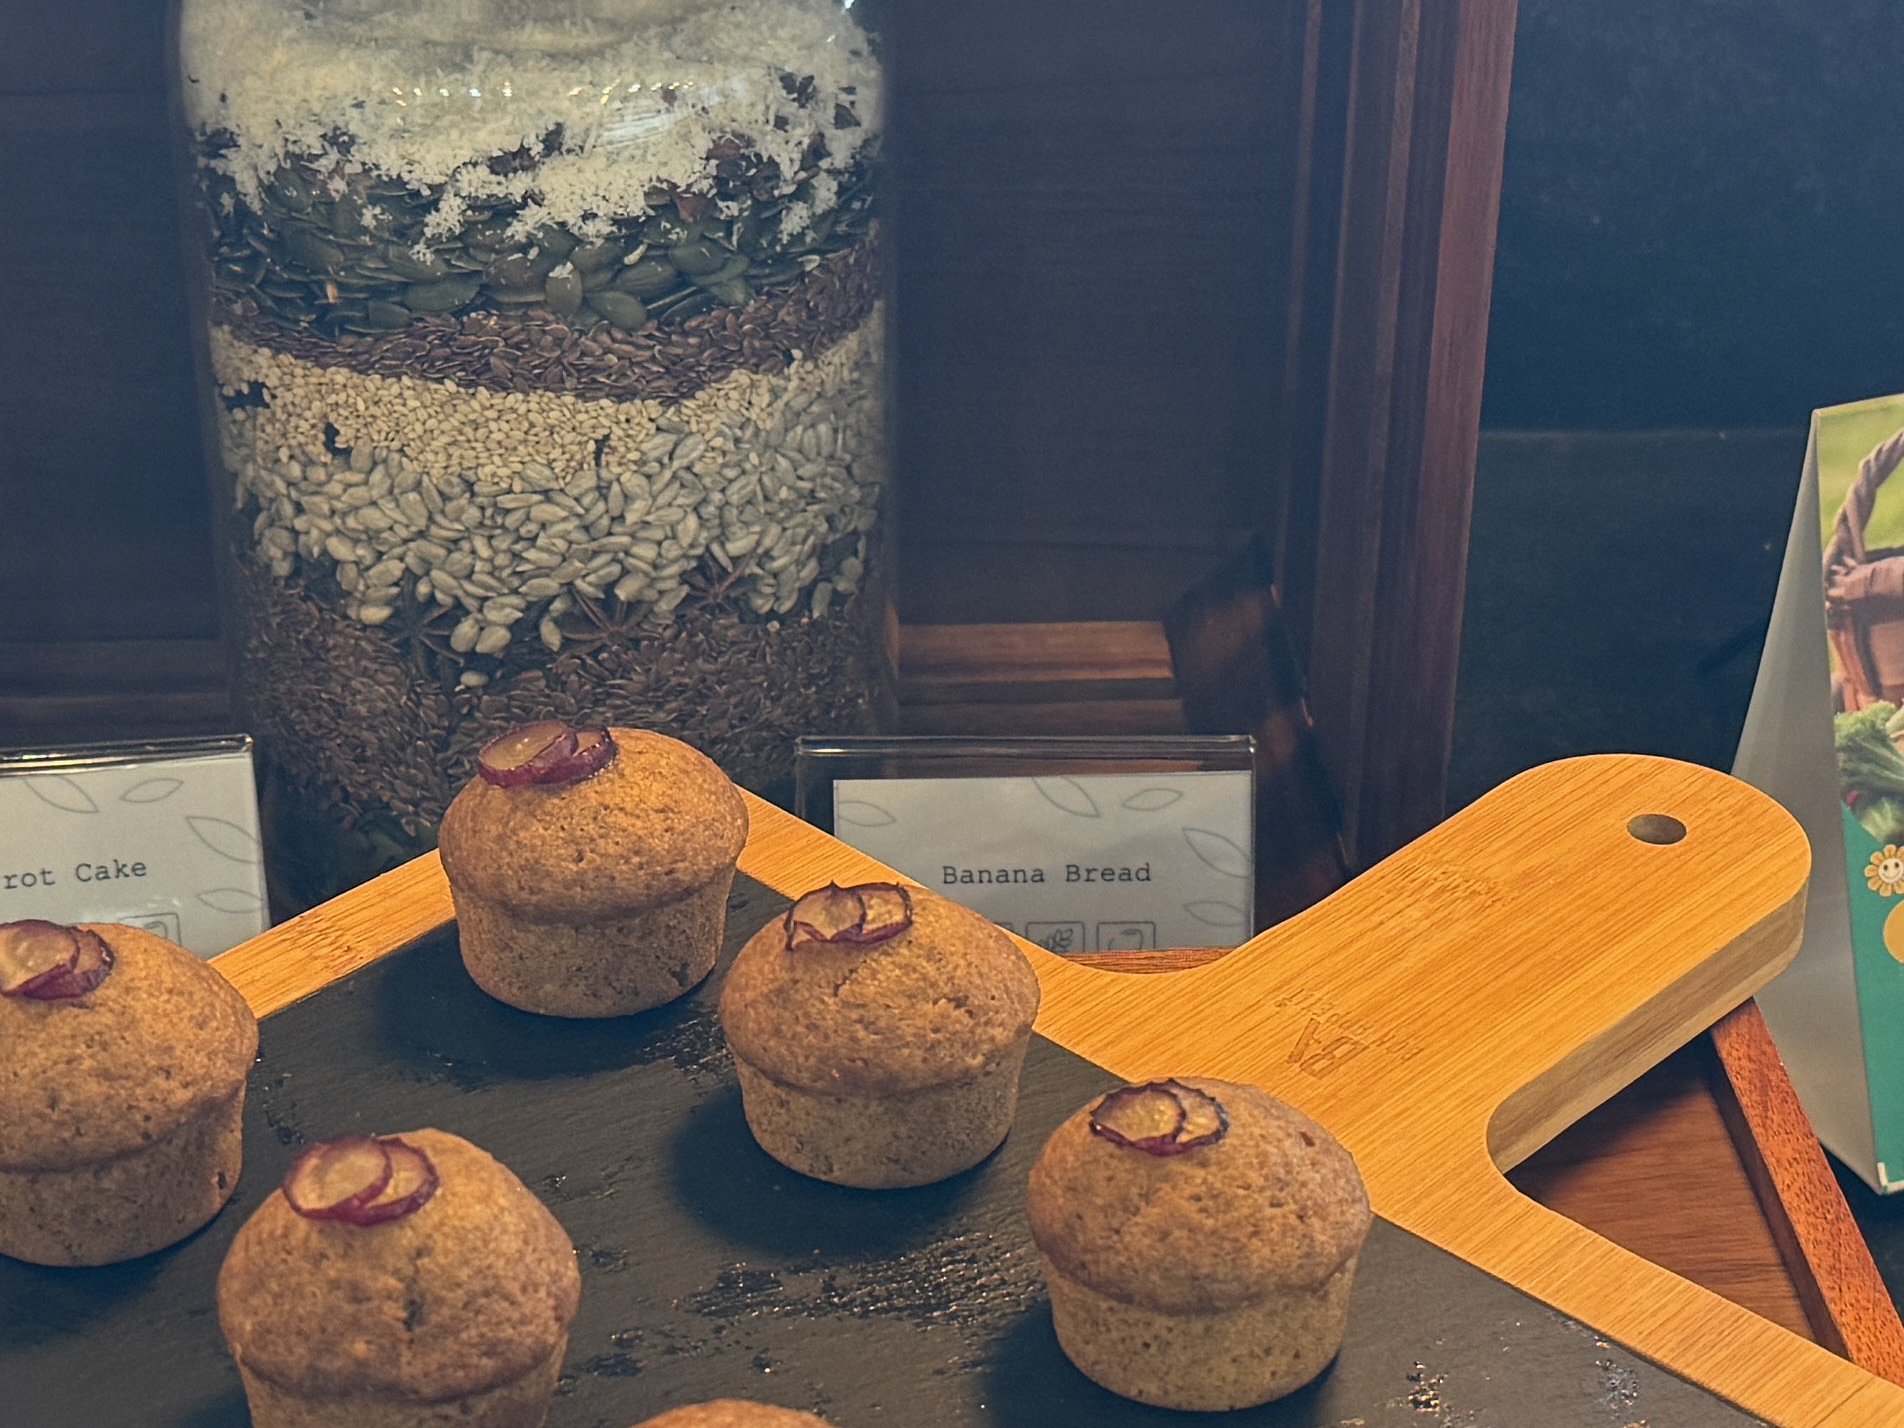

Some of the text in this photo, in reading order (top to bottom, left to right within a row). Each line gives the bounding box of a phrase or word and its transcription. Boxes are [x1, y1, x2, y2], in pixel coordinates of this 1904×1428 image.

[74, 858, 148, 883] Cake
[942, 862, 1152, 885] Banana Bread
